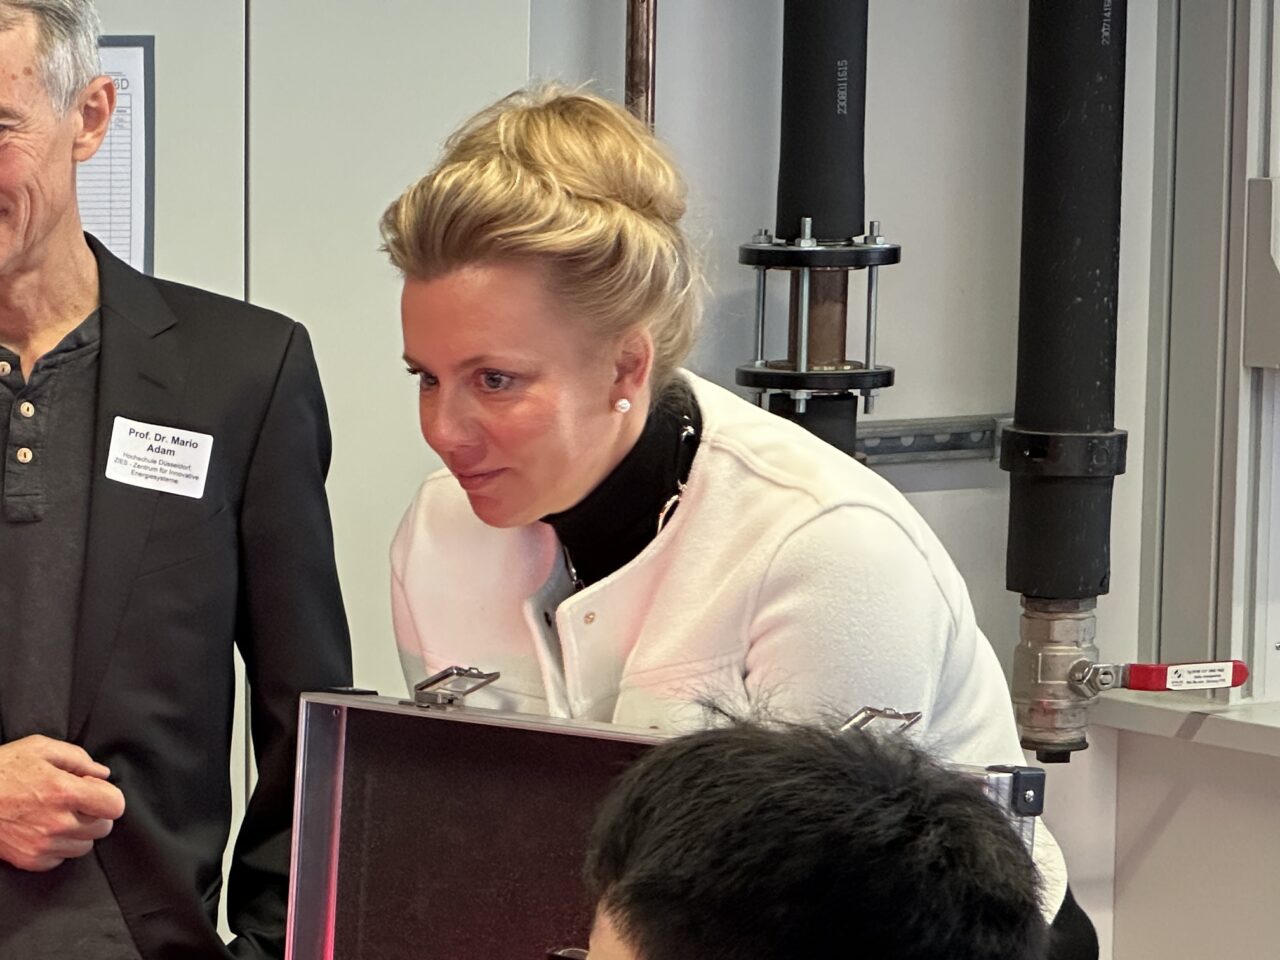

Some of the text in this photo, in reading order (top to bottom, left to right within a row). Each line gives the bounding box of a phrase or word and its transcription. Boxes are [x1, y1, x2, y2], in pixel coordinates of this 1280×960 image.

[128, 427, 199, 449] Prof. Dr. Mario
[147, 444, 176, 456] Adam
[123, 452, 157, 464] Hochschule
[130, 469, 179, 484] Energiesysteme
[132, 460, 159, 472] Zentrum
[168, 469, 200, 481] Innovative
